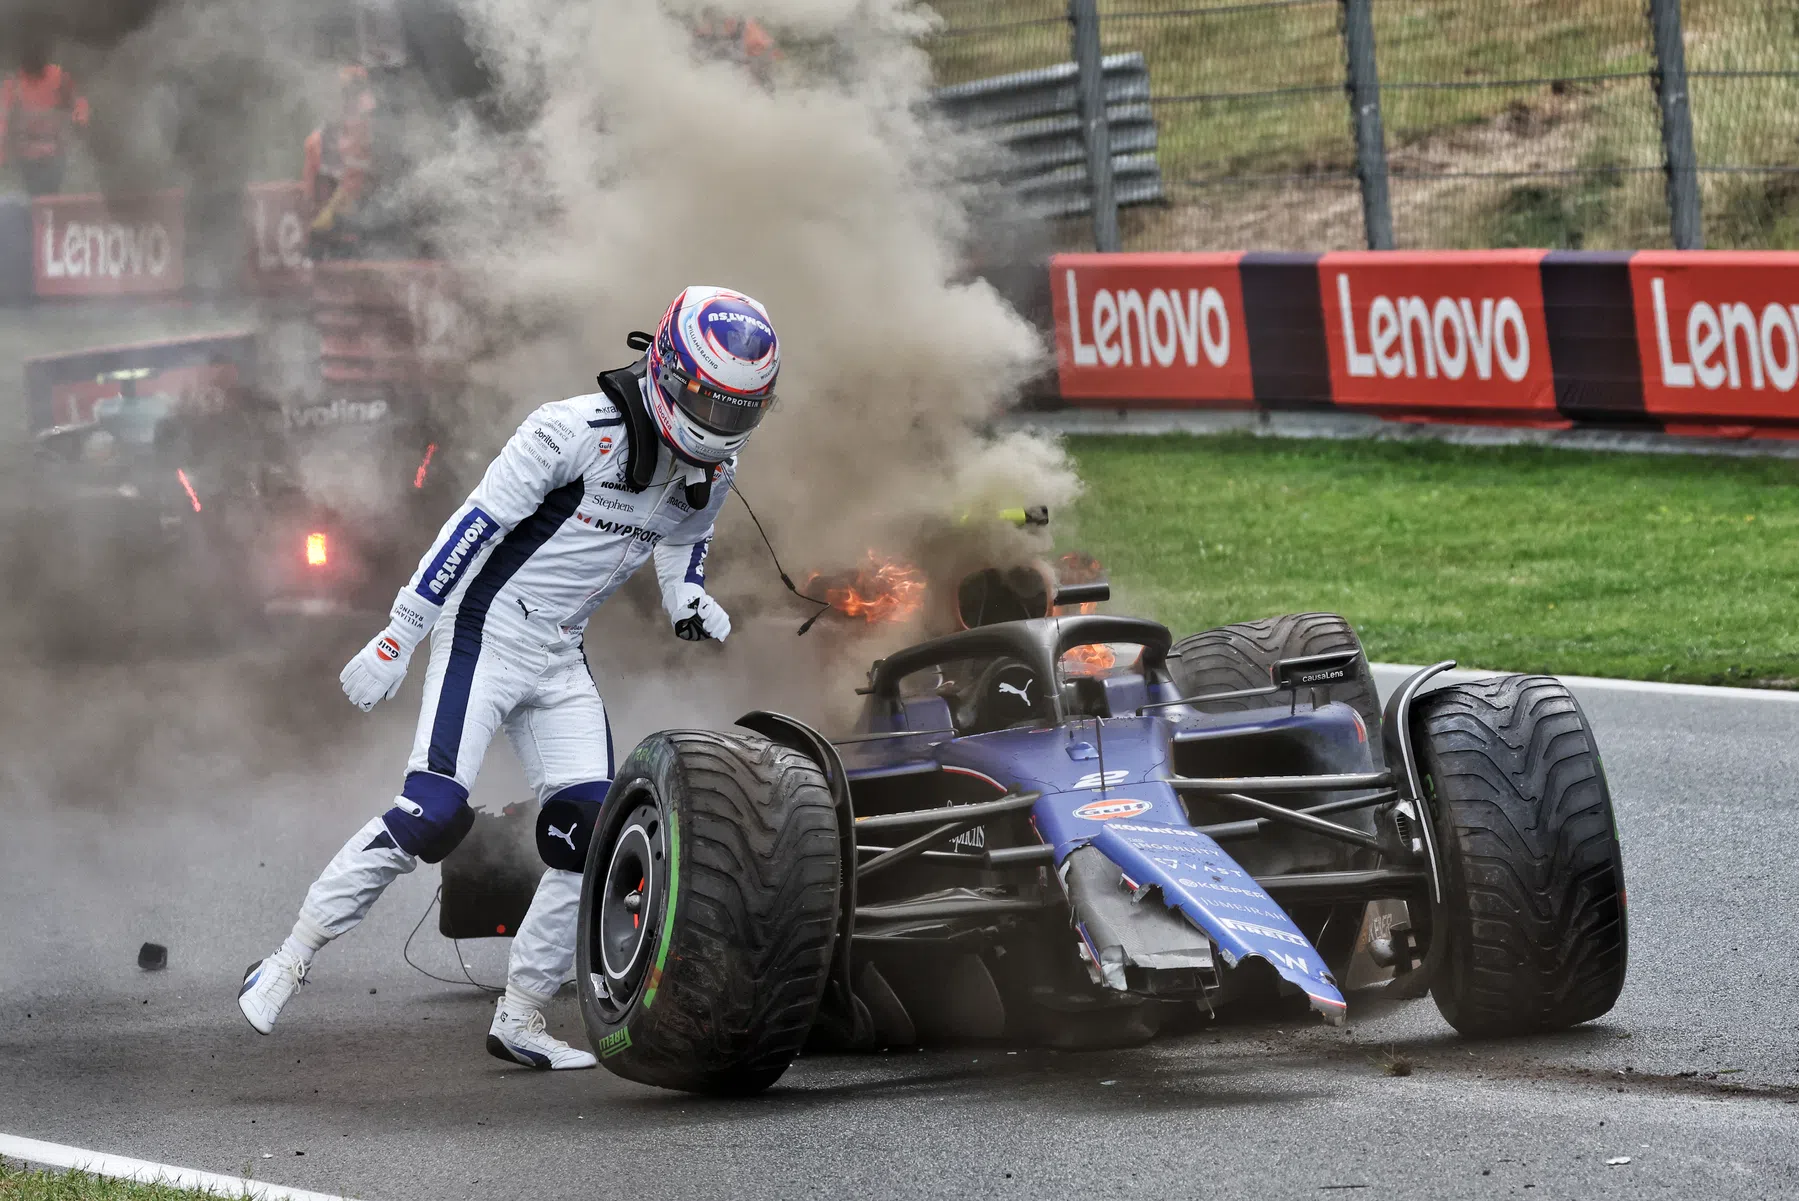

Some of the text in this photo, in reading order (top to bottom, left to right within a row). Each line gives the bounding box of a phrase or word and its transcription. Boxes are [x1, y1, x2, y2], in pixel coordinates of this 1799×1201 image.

[44, 208, 170, 278] Lenovo
[708, 312, 772, 337] KOMATSU
[1066, 269, 1230, 368] Lenovo
[1337, 273, 1530, 382] Lenovo
[1651, 276, 1799, 392] Leno
[712, 392, 760, 408] MYPROTEIN
[592, 495, 635, 513] Stephens
[429, 516, 489, 595] KOMATSU
[399, 604, 424, 622] RACING
[378, 640, 400, 659] Gulf
[1302, 670, 1344, 682] causaLens
[1073, 770, 1129, 788] 2
[1107, 823, 1198, 837] KOMATSU
[1132, 842, 1220, 856] INGENUITY
[1183, 862, 1242, 878] VAST
[1198, 881, 1267, 900] KEEPER
[1200, 897, 1287, 922] JUMEIRAH
[1218, 917, 1309, 948] PIRELLI
[599, 1025, 632, 1059] PIRELLI
